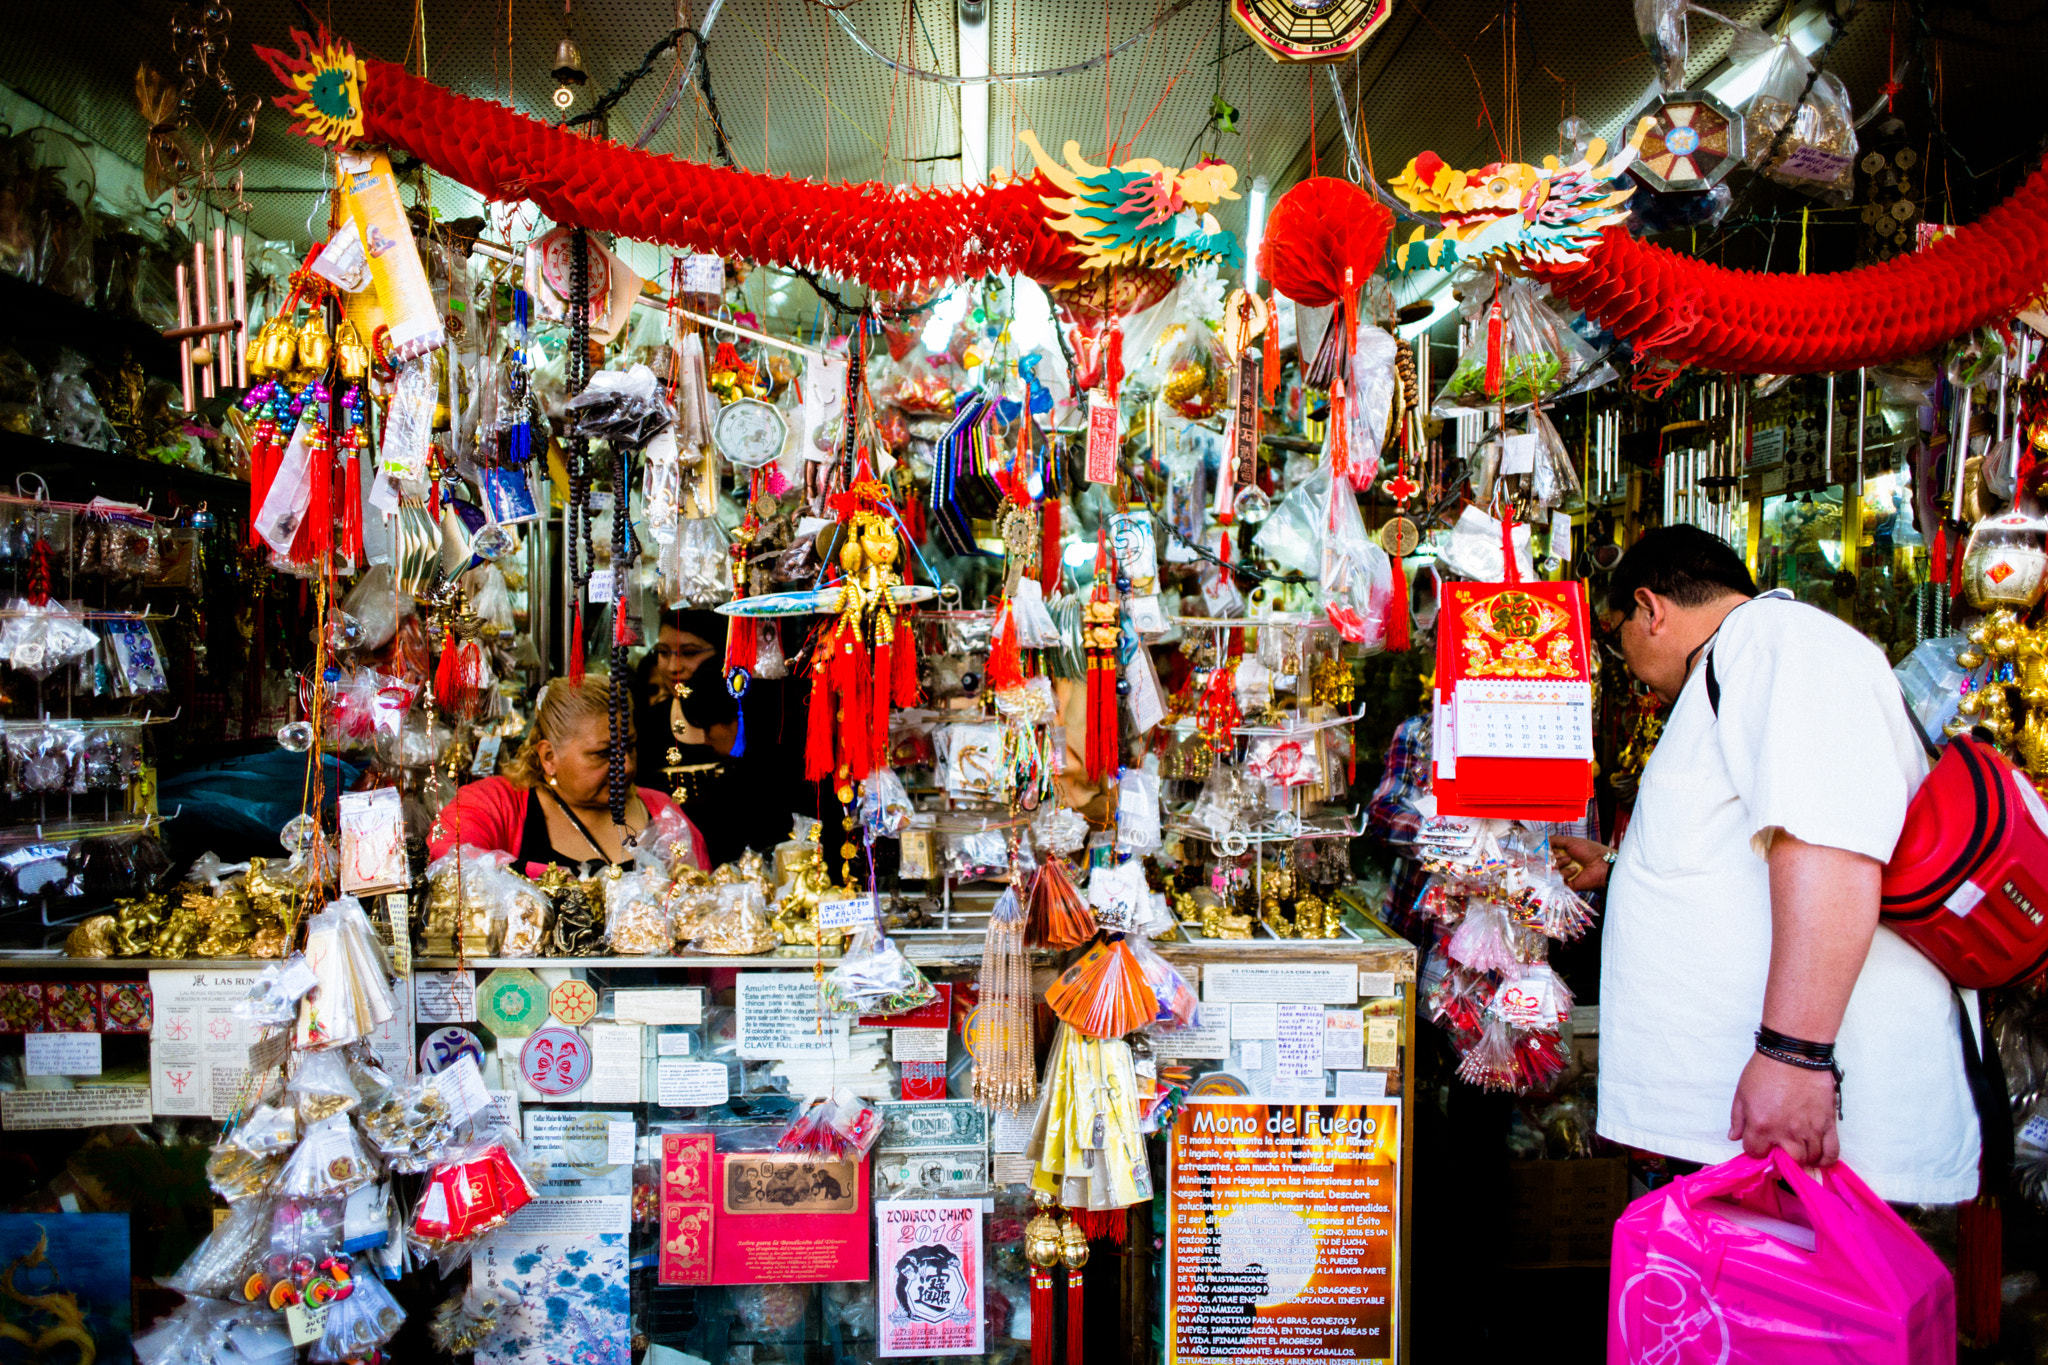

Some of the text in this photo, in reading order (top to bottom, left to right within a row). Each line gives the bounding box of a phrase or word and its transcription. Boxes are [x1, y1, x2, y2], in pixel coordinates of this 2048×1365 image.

[1493, 593, 1538, 637] 福
[2002, 881, 2044, 925] MOOMIN
[214, 978, 232, 986] LAS
[912, 1118, 951, 1132] ONE
[1193, 1111, 1376, 1138] Mono de Fuego
[1178, 1135, 1187, 1144] El
[1214, 1136, 1263, 1145] incrementa
[1265, 1136, 1273, 1145] la
[1275, 1137, 1333, 1146] comunicación,
[1336, 1136, 1344, 1145] el
[1379, 1140, 1384, 1148] y
[1178, 1148, 1186, 1157] el
[1189, 1149, 1222, 1160] ingenio,
[1223, 1149, 1278, 1160] ayudándonos
[1288, 1149, 1324, 1158] resolver
[1326, 1151, 1375, 1159] situaciones
[1178, 1163, 1233, 1172] estresantes,
[1252, 1162, 1280, 1171] mucha
[1282, 1163, 1334, 1174] tranquilidad
[1178, 1175, 1216, 1184] Minimiza
[1219, 1175, 1231, 1184] los
[1233, 1176, 1264, 1187] riesgos
[1267, 1178, 1286, 1187] para
[1289, 1176, 1301, 1185] las
[1303, 1177, 1352, 1185] inversiones
[1367, 1177, 1379, 1186] los
[1178, 1189, 1370, 1200] negocios y nos brinda prosperidad. Descubre
[1178, 1202, 1221, 1210] soluciones
[1231, 1203, 1257, 1212] viejos
[1306, 1205, 1311, 1214] y
[1314, 1203, 1338, 1212] malos
[1340, 1204, 1390, 1212] entendidos.
[887, 1209, 973, 1223] ZODIACO CHINO
[1178, 1215, 1186, 1223] El
[1189, 1216, 1203, 1224] ser
[1306, 1218, 1344, 1226] personas
[1346, 1216, 1354, 1225] al
[1357, 1214, 1380, 1225] Éxito
[898, 1223, 963, 1243] 2016
[1206, 1275, 1268, 1283] FRUSTRACIONES
[1192, 1283, 1209, 1293] AÑO
[1211, 1285, 1262, 1293] ASOMBROSO
[1191, 1314, 1209, 1323] AÑO
[1211, 1316, 1250, 1324] POSITIVO
[1277, 1317, 1309, 1325] CABRAS,
[1311, 1317, 1348, 1325] CONEJOS
[890, 1328, 914, 1336] AÑO
[942, 1327, 975, 1335] MONO
[1177, 1326, 1209, 1334] BUEYES,
[1211, 1326, 1279, 1335] IMPROVISACIÓN,
[1341, 1326, 1367, 1335] ÁREAS
[1191, 1345, 1209, 1354] AÑO
[1210, 1347, 1272, 1355] EMOCIONANTE:
[1274, 1347, 1305, 1355] GALLOS
[1314, 1348, 1356, 1356] CABALLOS.
